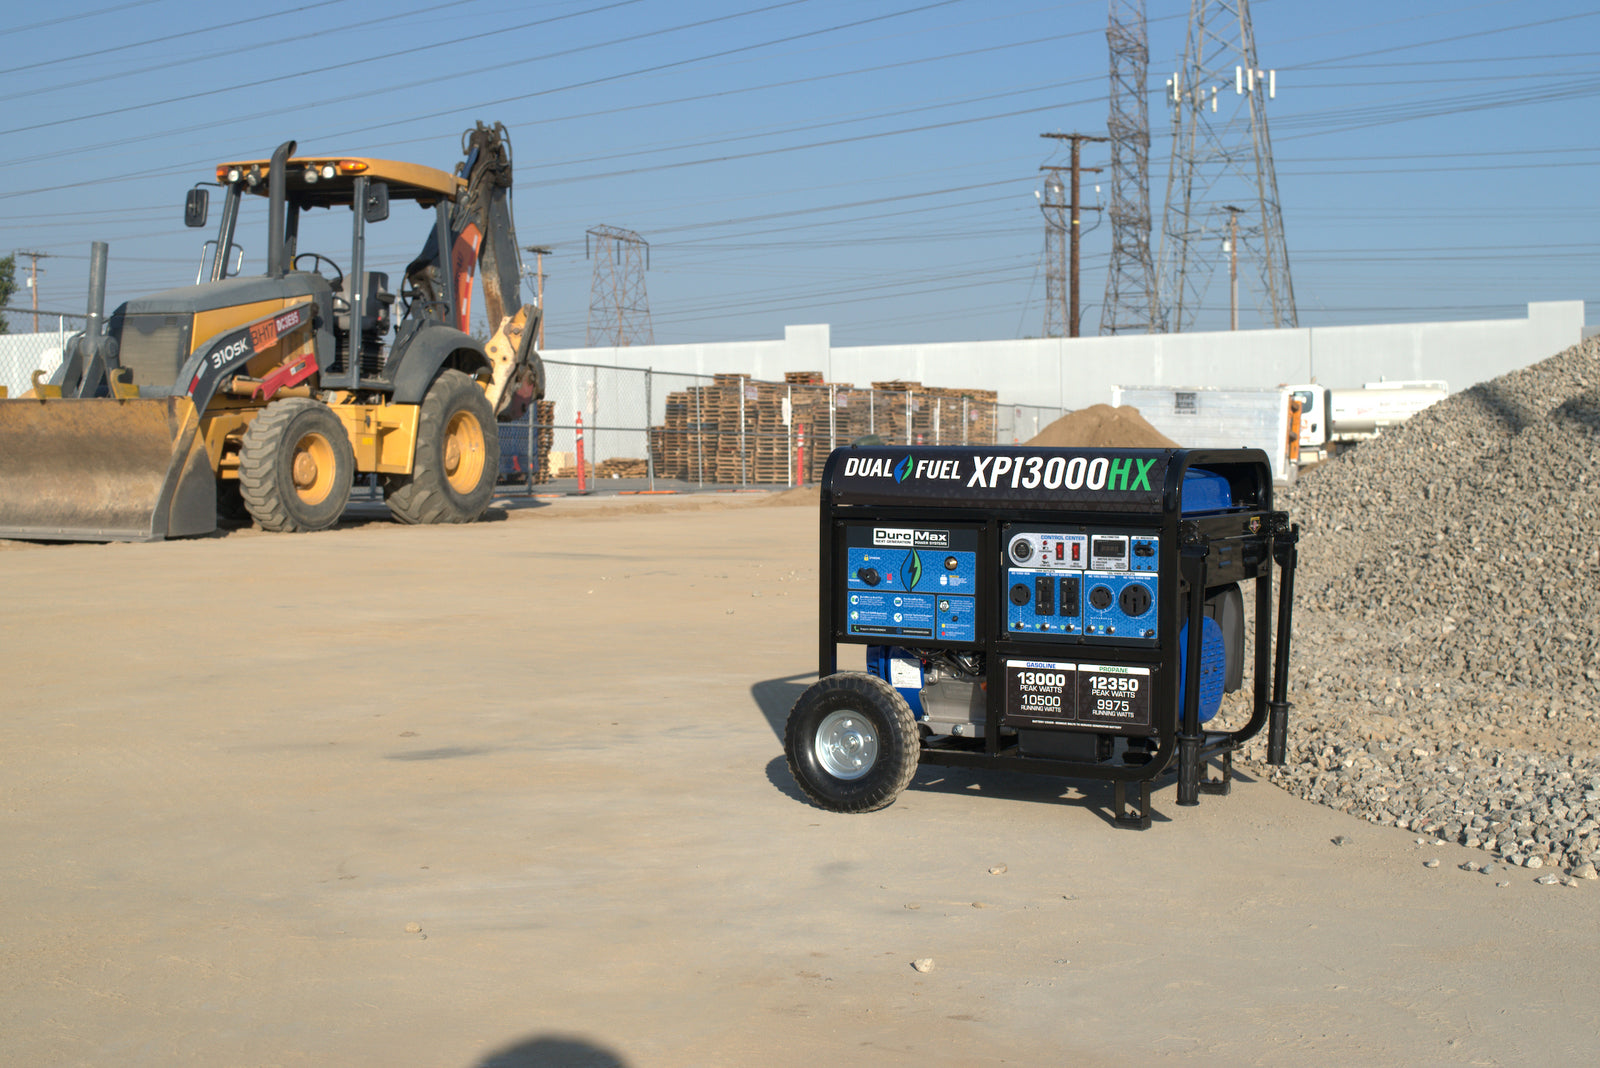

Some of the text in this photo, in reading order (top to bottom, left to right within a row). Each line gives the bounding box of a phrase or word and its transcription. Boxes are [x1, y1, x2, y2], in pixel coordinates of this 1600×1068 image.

[844, 455, 1157, 491] DUAL FUEL XP13000HX
[1026, 661, 1056, 669] GASOLINE
[1099, 666, 1128, 674] PROPANE
[1017, 671, 1066, 687] 13000
[1088, 676, 1139, 692] 12350
[1020, 684, 1062, 694] PEAK WATTS
[1091, 689, 1136, 699] PEAK WATTS
[1022, 694, 1061, 707] 10500
[1097, 699, 1130, 712] 9975
[1020, 704, 1043, 712] RUNNING
[1092, 709, 1135, 719] RUNNING WATTS
